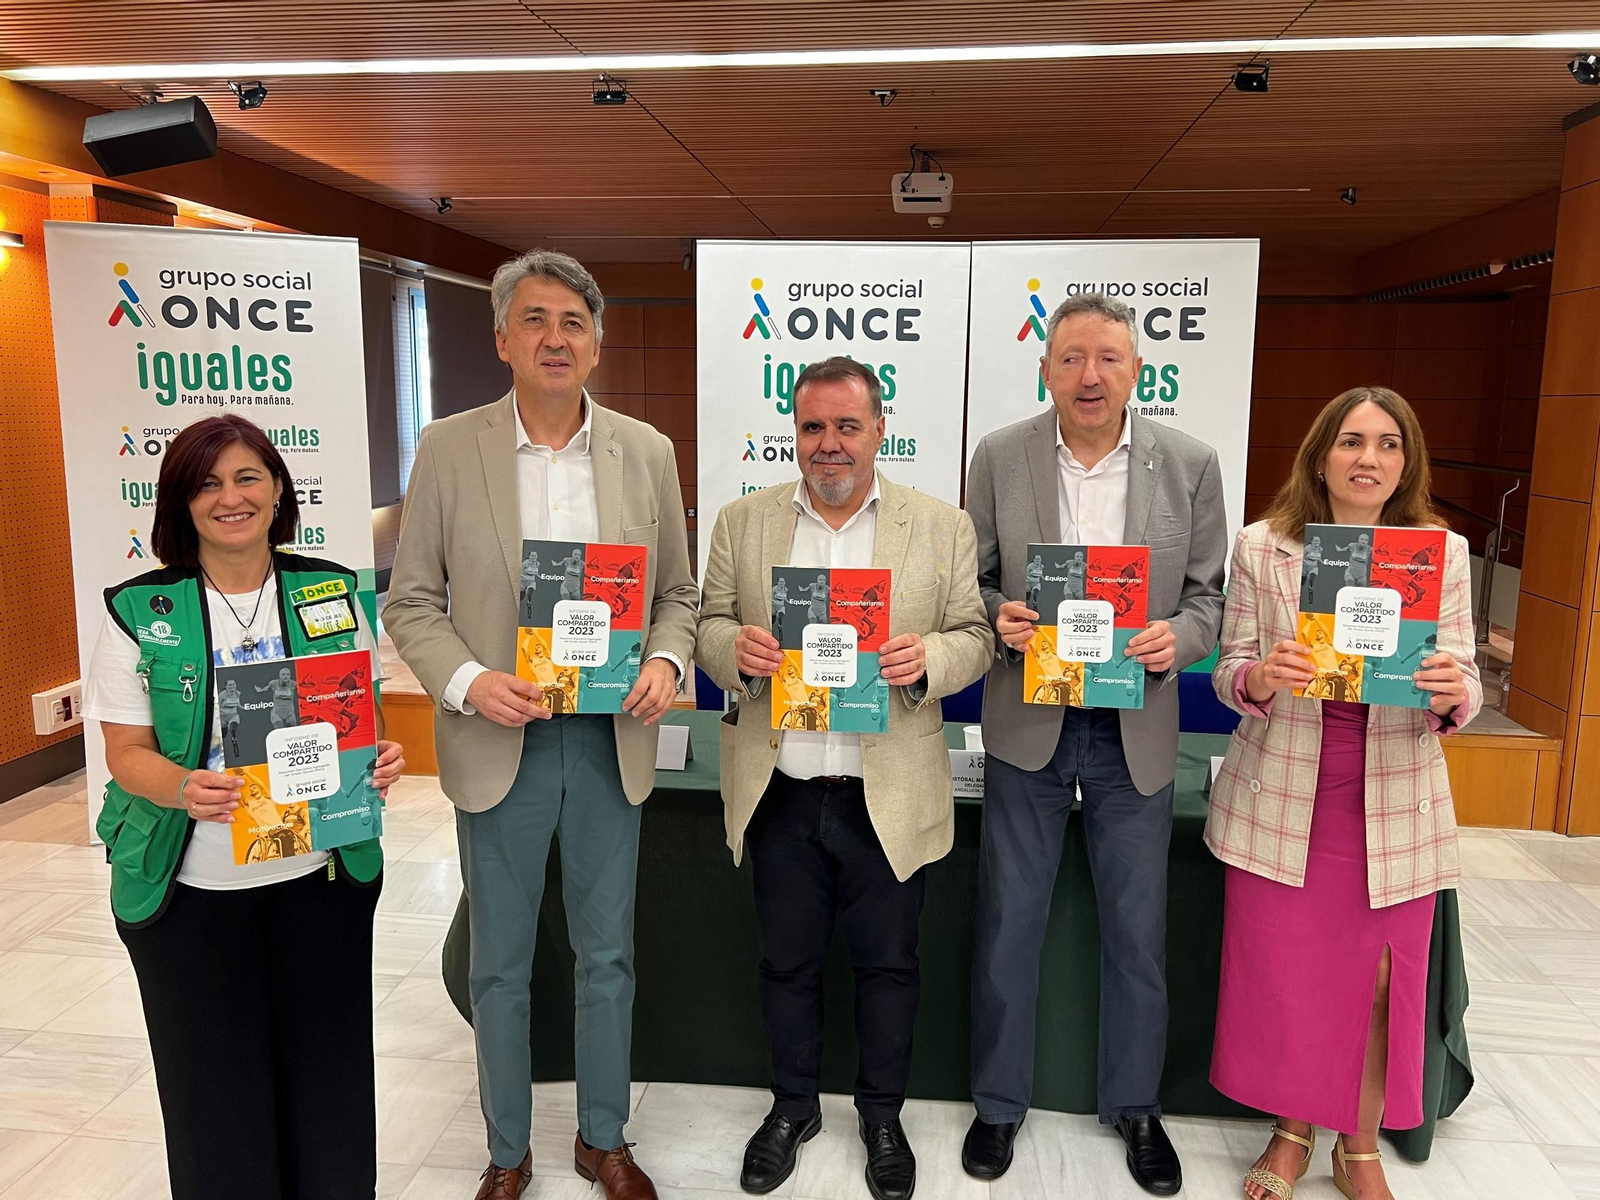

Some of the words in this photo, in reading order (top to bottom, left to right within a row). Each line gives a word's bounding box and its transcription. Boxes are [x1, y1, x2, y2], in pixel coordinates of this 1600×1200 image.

[159, 269, 236, 290] grupo
[243, 271, 312, 290] social
[788, 282, 854, 301] grupo
[860, 279, 922, 298] social
[1142, 277, 1208, 296] social
[161, 295, 313, 332] ONCE
[787, 307, 921, 341] ONCE
[1143, 307, 1206, 341] CE
[137, 342, 292, 406] iguales
[181, 394, 204, 405] Para
[207, 394, 227, 406] hoy.
[230, 394, 252, 405] Para
[255, 394, 294, 405] mañana.
[1141, 405, 1178, 416] mañana.
[143, 428, 180, 437] grupo
[267, 425, 320, 446] uales
[763, 434, 794, 444] grupo
[880, 434, 916, 456] ales
[763, 447, 794, 462] ON
[291, 476, 322, 485] social
[295, 490, 322, 505] CE
[1323, 559, 1350, 567] Equipo
[1378, 562, 1437, 571] Compañerismo
[540, 573, 566, 582] Equipo
[590, 576, 640, 584] Compañerismo
[1045, 575, 1068, 583] Equipo
[1093, 576, 1143, 584] Compañerismo
[306, 582, 342, 598] ONCE
[836, 599, 885, 607] Compañerismo
[1354, 601, 1382, 609] VALOR
[1340, 606, 1396, 616] COMPARTIDO
[1352, 613, 1382, 624] 2023
[568, 626, 594, 636] 2023
[1072, 624, 1098, 633] 2023
[806, 642, 854, 650] COMPARTIDO
[1355, 642, 1384, 651] ONCE
[817, 649, 842, 658] 2023
[1093, 677, 1135, 685] Compromiso
[1373, 671, 1413, 681] Compromi
[588, 681, 630, 689] Compromiso
[306, 688, 366, 703] Compañerismo
[244, 700, 275, 712] Equipo
[838, 701, 880, 709] Compromiso
[287, 740, 318, 750] VALOR
[272, 743, 333, 759] COMPARTIDO
[288, 753, 320, 767] 2023
[296, 783, 327, 795] ONCE
[321, 805, 370, 821] Compromiso
